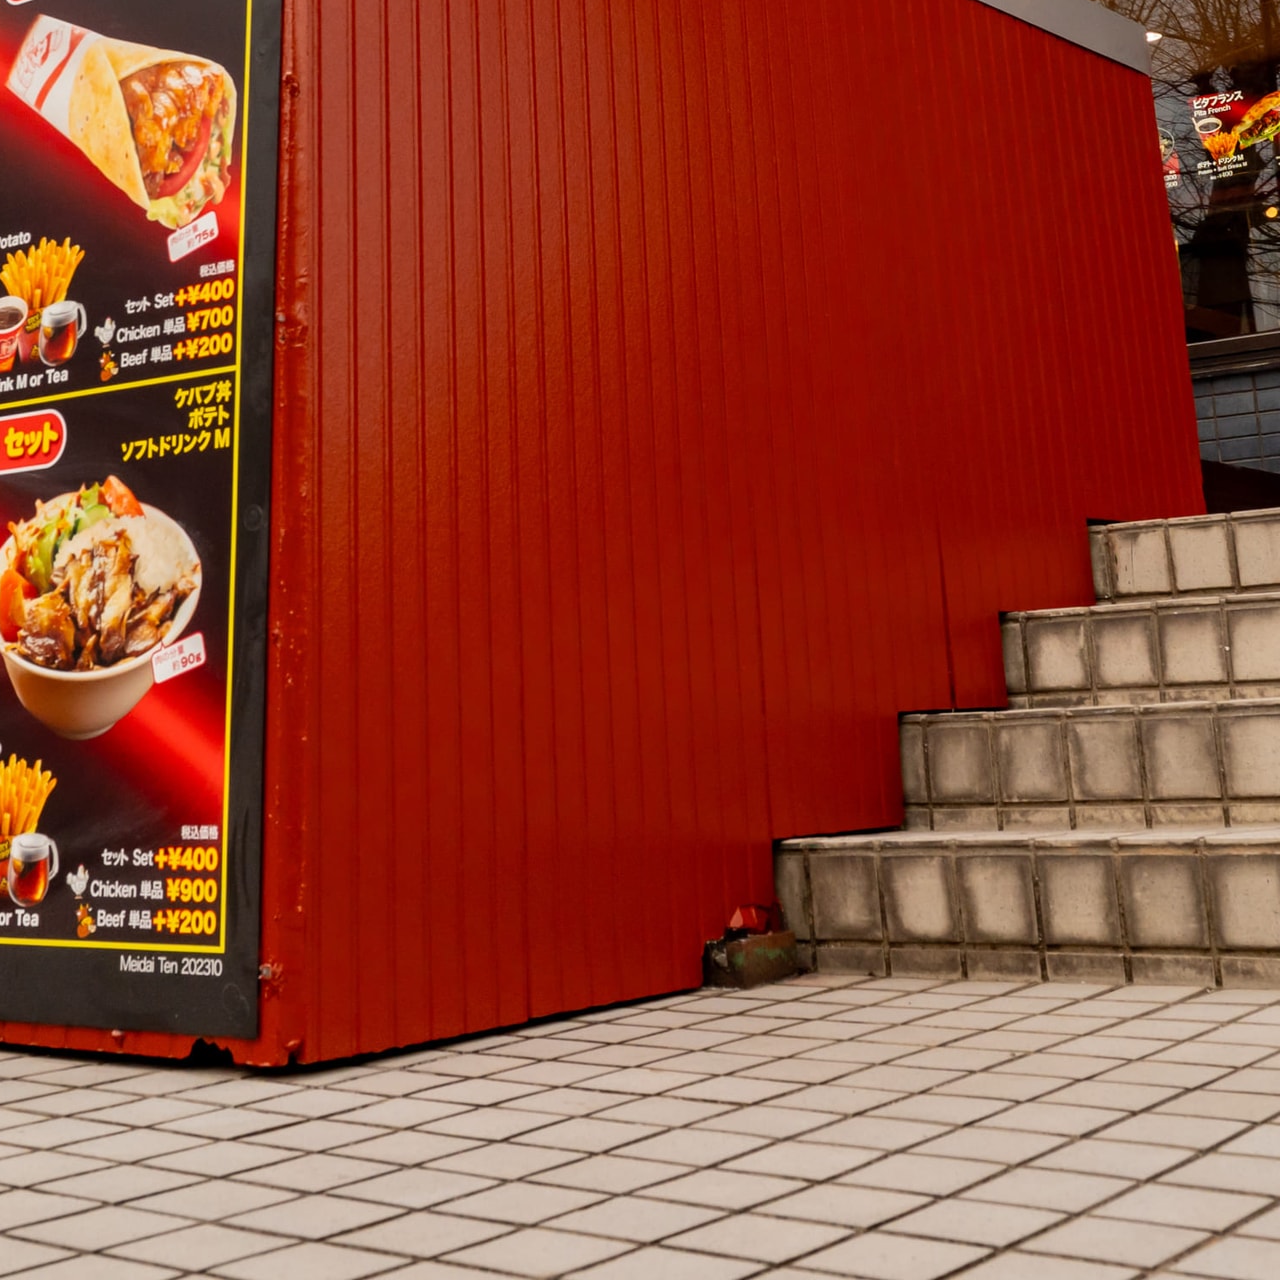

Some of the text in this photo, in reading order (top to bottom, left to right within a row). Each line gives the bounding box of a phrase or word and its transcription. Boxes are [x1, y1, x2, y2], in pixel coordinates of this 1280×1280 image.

[1194, 104, 1231, 118] Pita French
[125, 278, 235, 314] セット Set +¥400
[116, 305, 234, 343] Chicken 単品 ¥700
[121, 332, 233, 368] Beef 単品 +¥200
[174, 380, 233, 409] ケバブ丼
[3, 424, 60, 457] セット
[121, 429, 231, 462] ソフトドリンク M
[101, 847, 219, 872] セット Set +¥400
[90, 878, 218, 903] Chicken 単品 ¥900
[15, 908, 39, 928] Tea
[97, 909, 217, 935] Beef 単品 +¥200
[120, 955, 222, 976] Meidai Ten 202310
